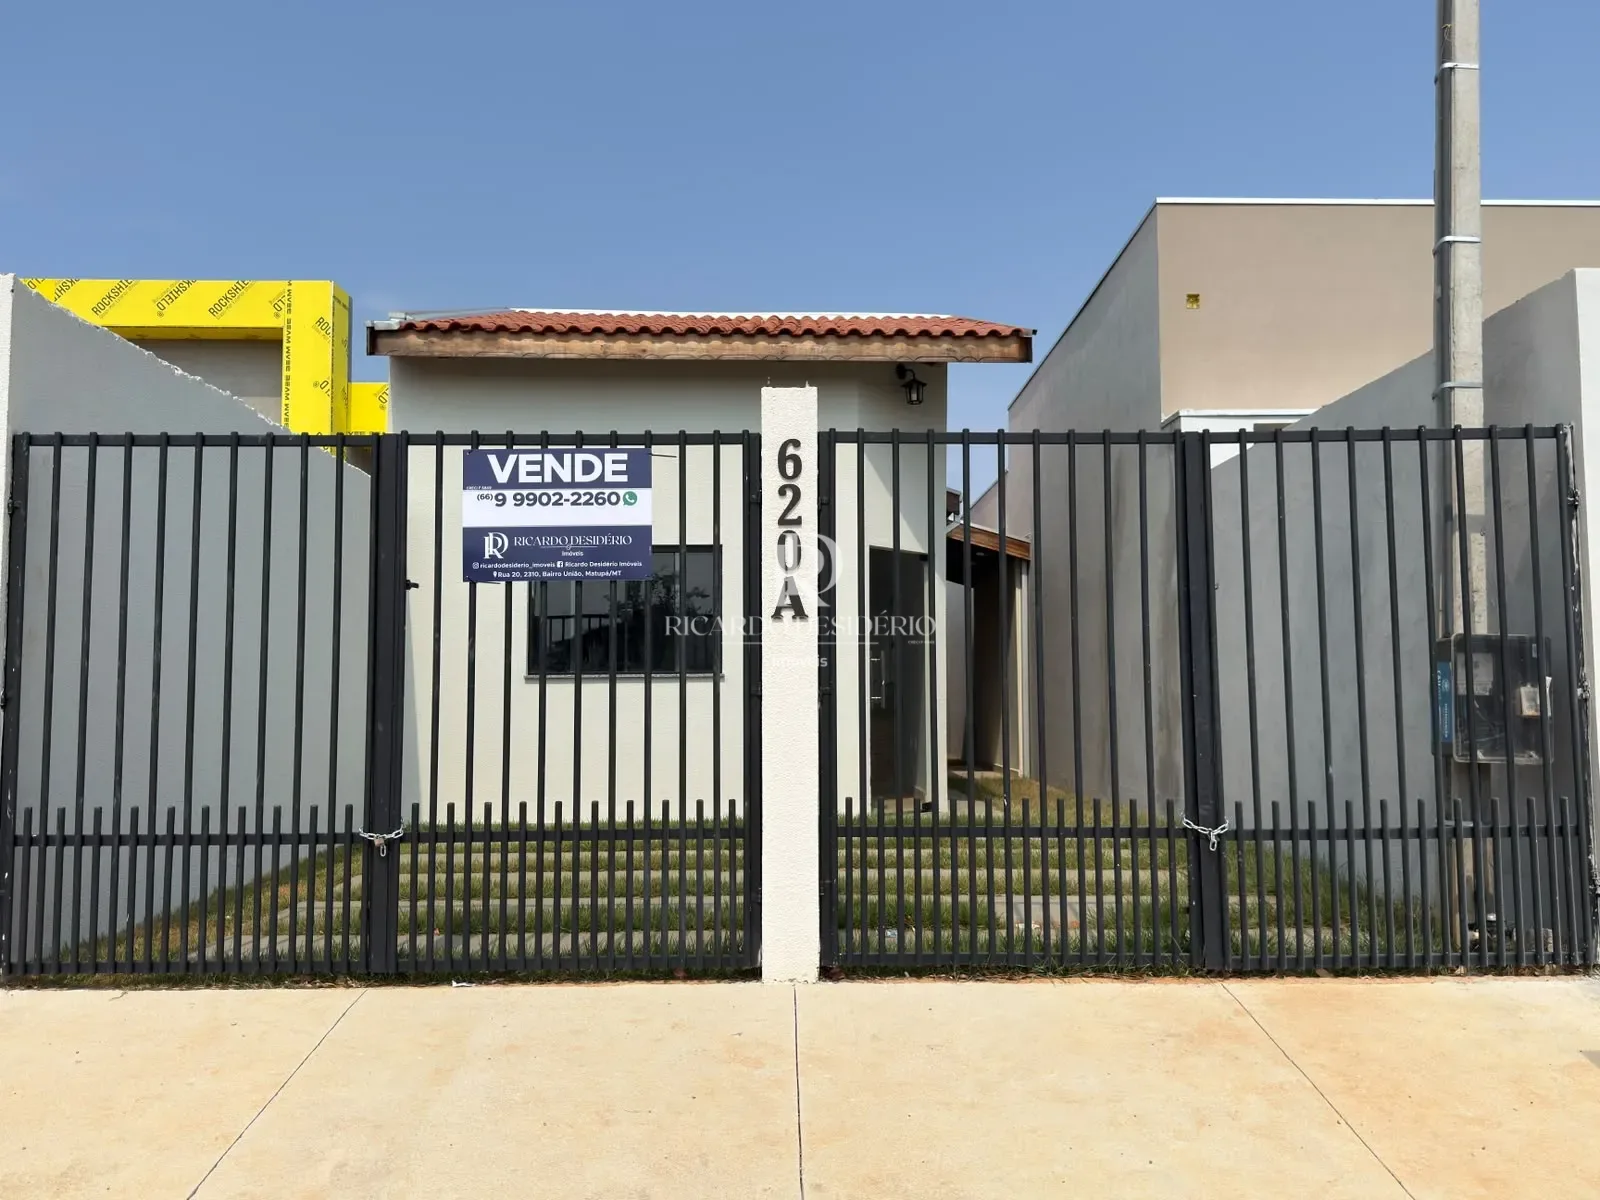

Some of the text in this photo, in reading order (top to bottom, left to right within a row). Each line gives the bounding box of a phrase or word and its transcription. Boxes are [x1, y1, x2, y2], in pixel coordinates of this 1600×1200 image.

[487, 453, 629, 484] VENDE
[494, 492, 507, 508] 9
[512, 491, 621, 508] 9902-2260
[771, 438, 809, 621] 620A
[513, 532, 633, 546] RICARDO DESIDÉRIO
[585, 569, 622, 577] Matupá/MT
